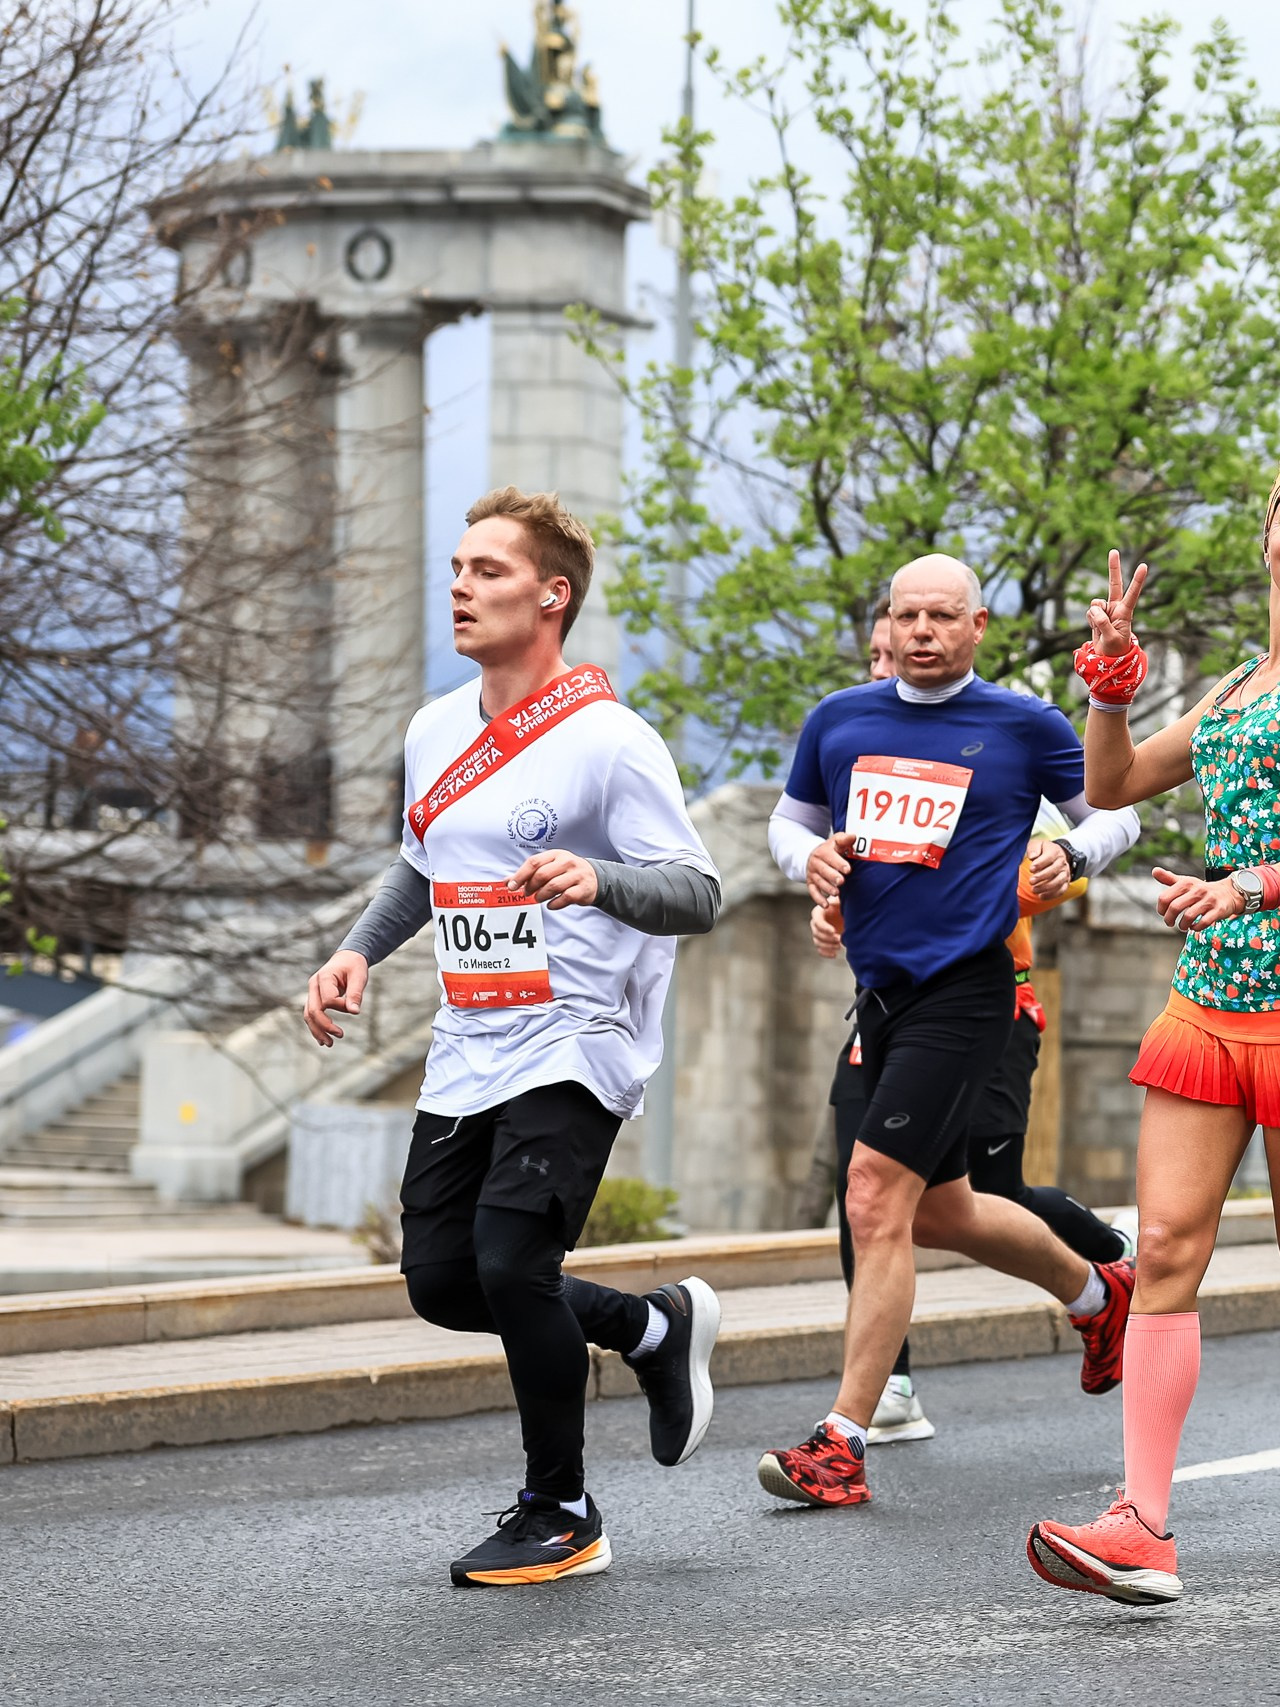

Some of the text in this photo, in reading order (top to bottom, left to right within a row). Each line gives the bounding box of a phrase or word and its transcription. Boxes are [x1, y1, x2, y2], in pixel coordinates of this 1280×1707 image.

[508, 671, 597, 727] ЭСТАФЕТА
[514, 684, 603, 739] КОРПОРАТИВНАЯ
[428, 735, 496, 804] КОРПОРАТИВНАЯ
[429, 746, 503, 814] ЭСТАФЕТА
[511, 798, 558, 821] ACTIVE TEAM
[856, 788, 956, 831] 19102
[856, 837, 867, 854] D
[438, 912, 537, 952] 106-4
[458, 957, 511, 969] Го Инвест 2
